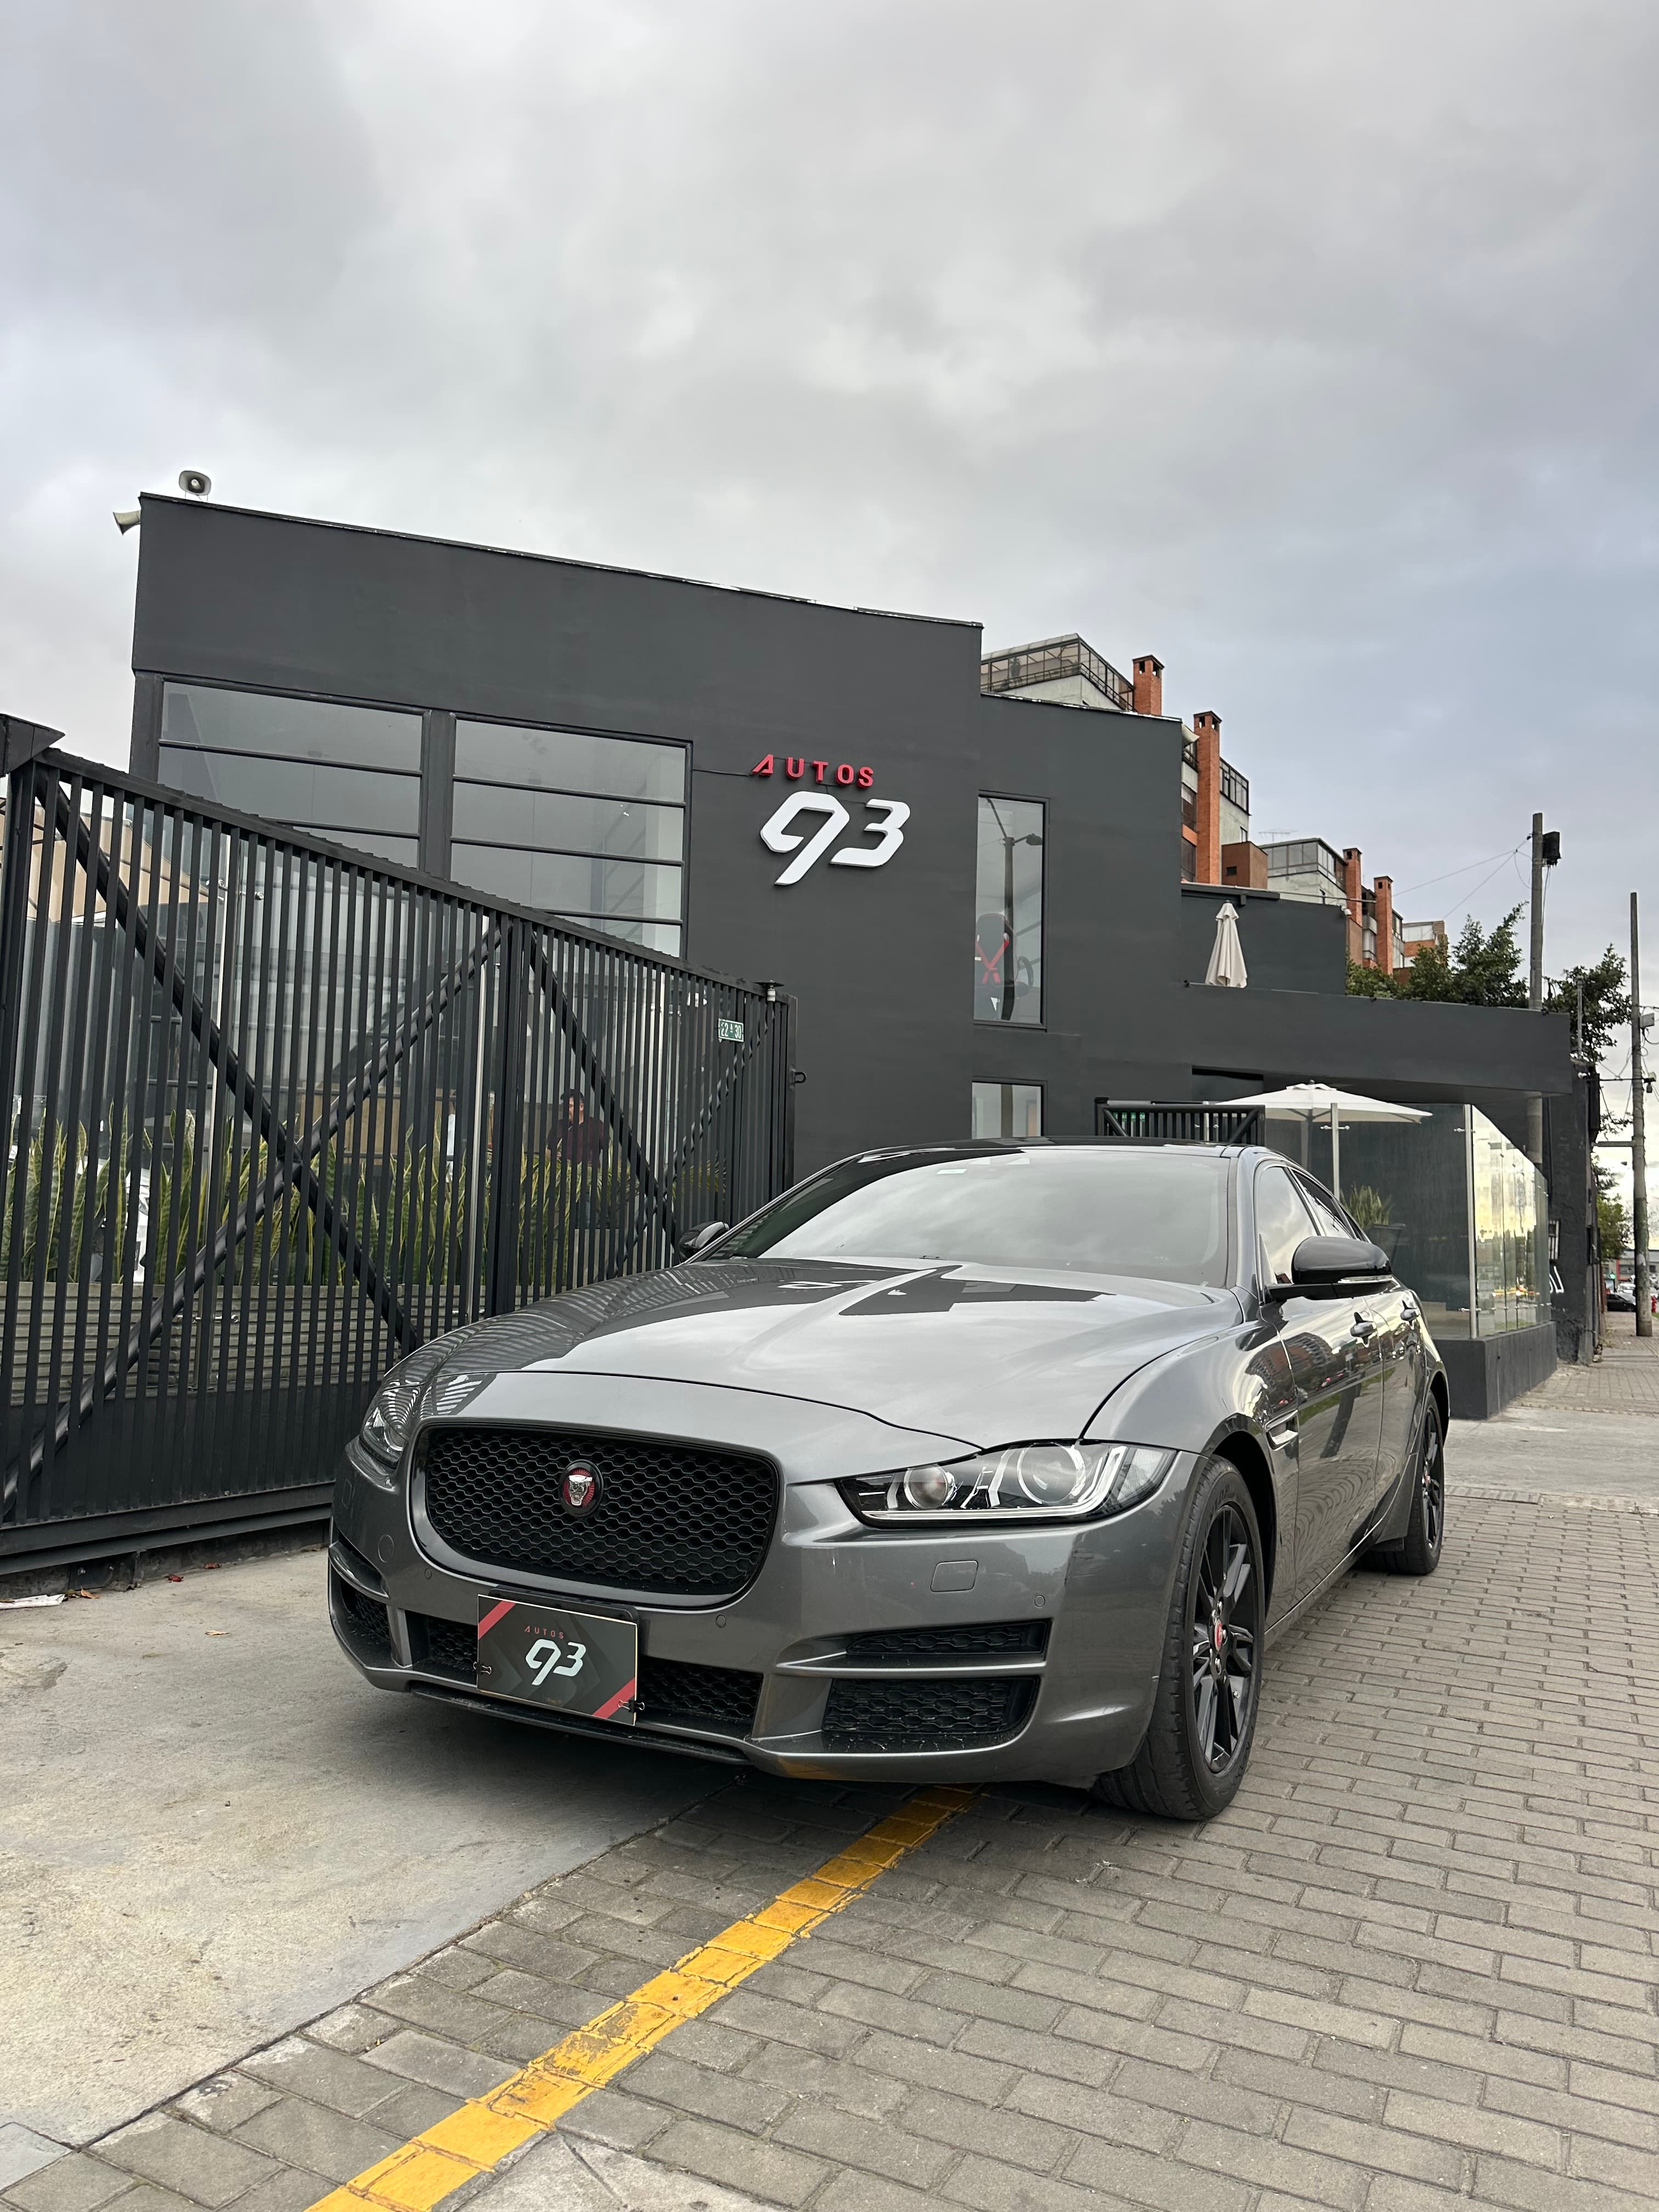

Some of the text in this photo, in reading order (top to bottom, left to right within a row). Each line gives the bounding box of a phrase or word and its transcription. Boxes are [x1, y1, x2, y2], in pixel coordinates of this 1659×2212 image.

[749, 754, 874, 788] AUTOS
[760, 791, 911, 885] 93
[524, 1626, 564, 1639] AUTOS
[525, 1638, 586, 1686] 93
